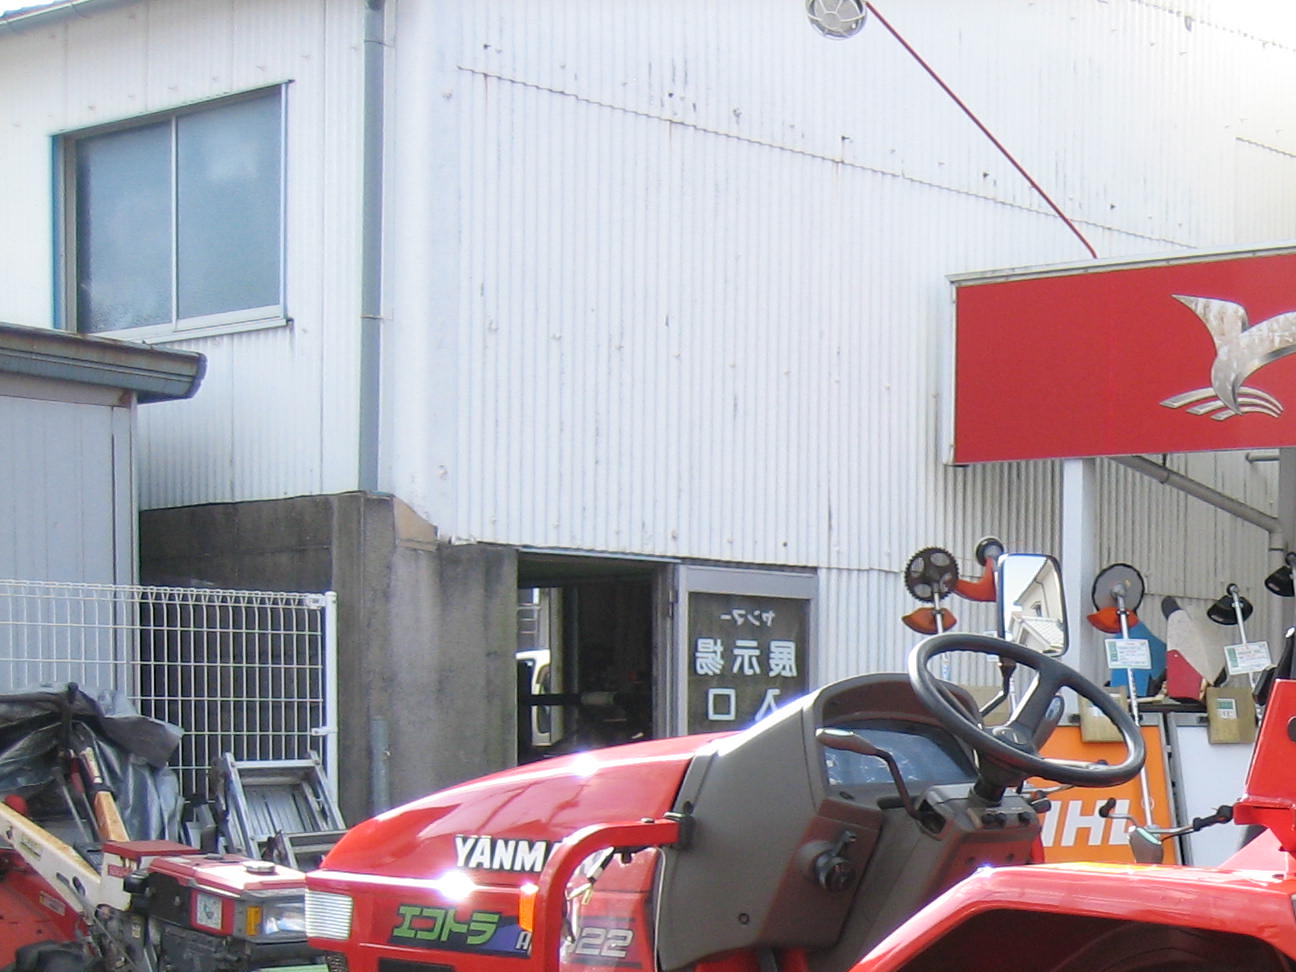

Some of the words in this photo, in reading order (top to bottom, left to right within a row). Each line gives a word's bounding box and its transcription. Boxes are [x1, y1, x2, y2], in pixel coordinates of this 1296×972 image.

[1041, 799, 1130, 847] IHL
[455, 836, 562, 873] YANM
[393, 906, 500, 945] エコトラ
[564, 927, 634, 958] 22
